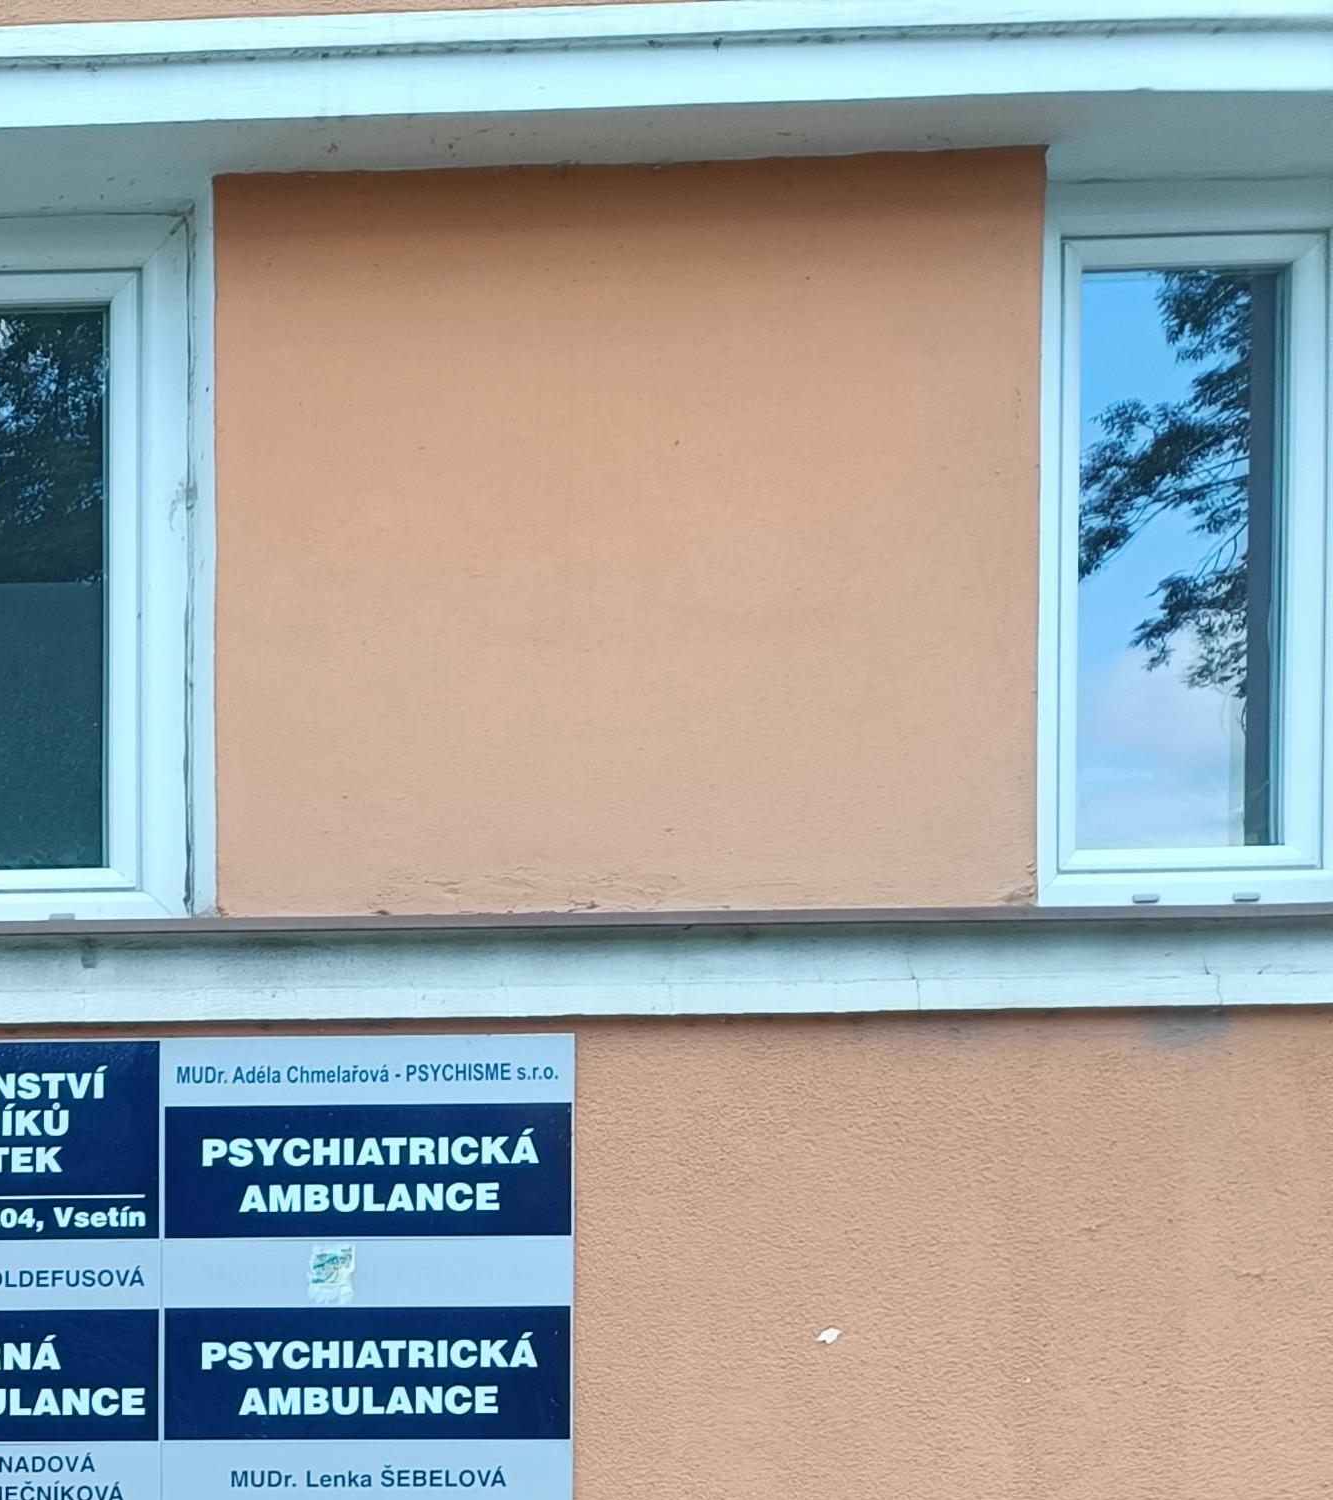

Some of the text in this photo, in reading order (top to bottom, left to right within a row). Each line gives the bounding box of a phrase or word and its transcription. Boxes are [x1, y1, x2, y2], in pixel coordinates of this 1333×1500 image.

[176, 1066, 228, 1084] MUDr.
[233, 1065, 282, 1083] Adéla
[286, 1064, 389, 1083] Chmelařová
[406, 1063, 511, 1082] PSYCHISME
[517, 1067, 559, 1080] s.r.o.
[201, 1128, 540, 1167] PSYCHIATRICKÁ
[239, 1182, 500, 1213] AMBULANCE
[54, 1206, 145, 1228] Vsetín
[201, 1332, 538, 1370] PSYCHIATRICKÁ
[238, 1385, 499, 1416] AMBULANCE
[231, 1465, 507, 1488] MUDr. Lenka ŠEBELOVÁ
